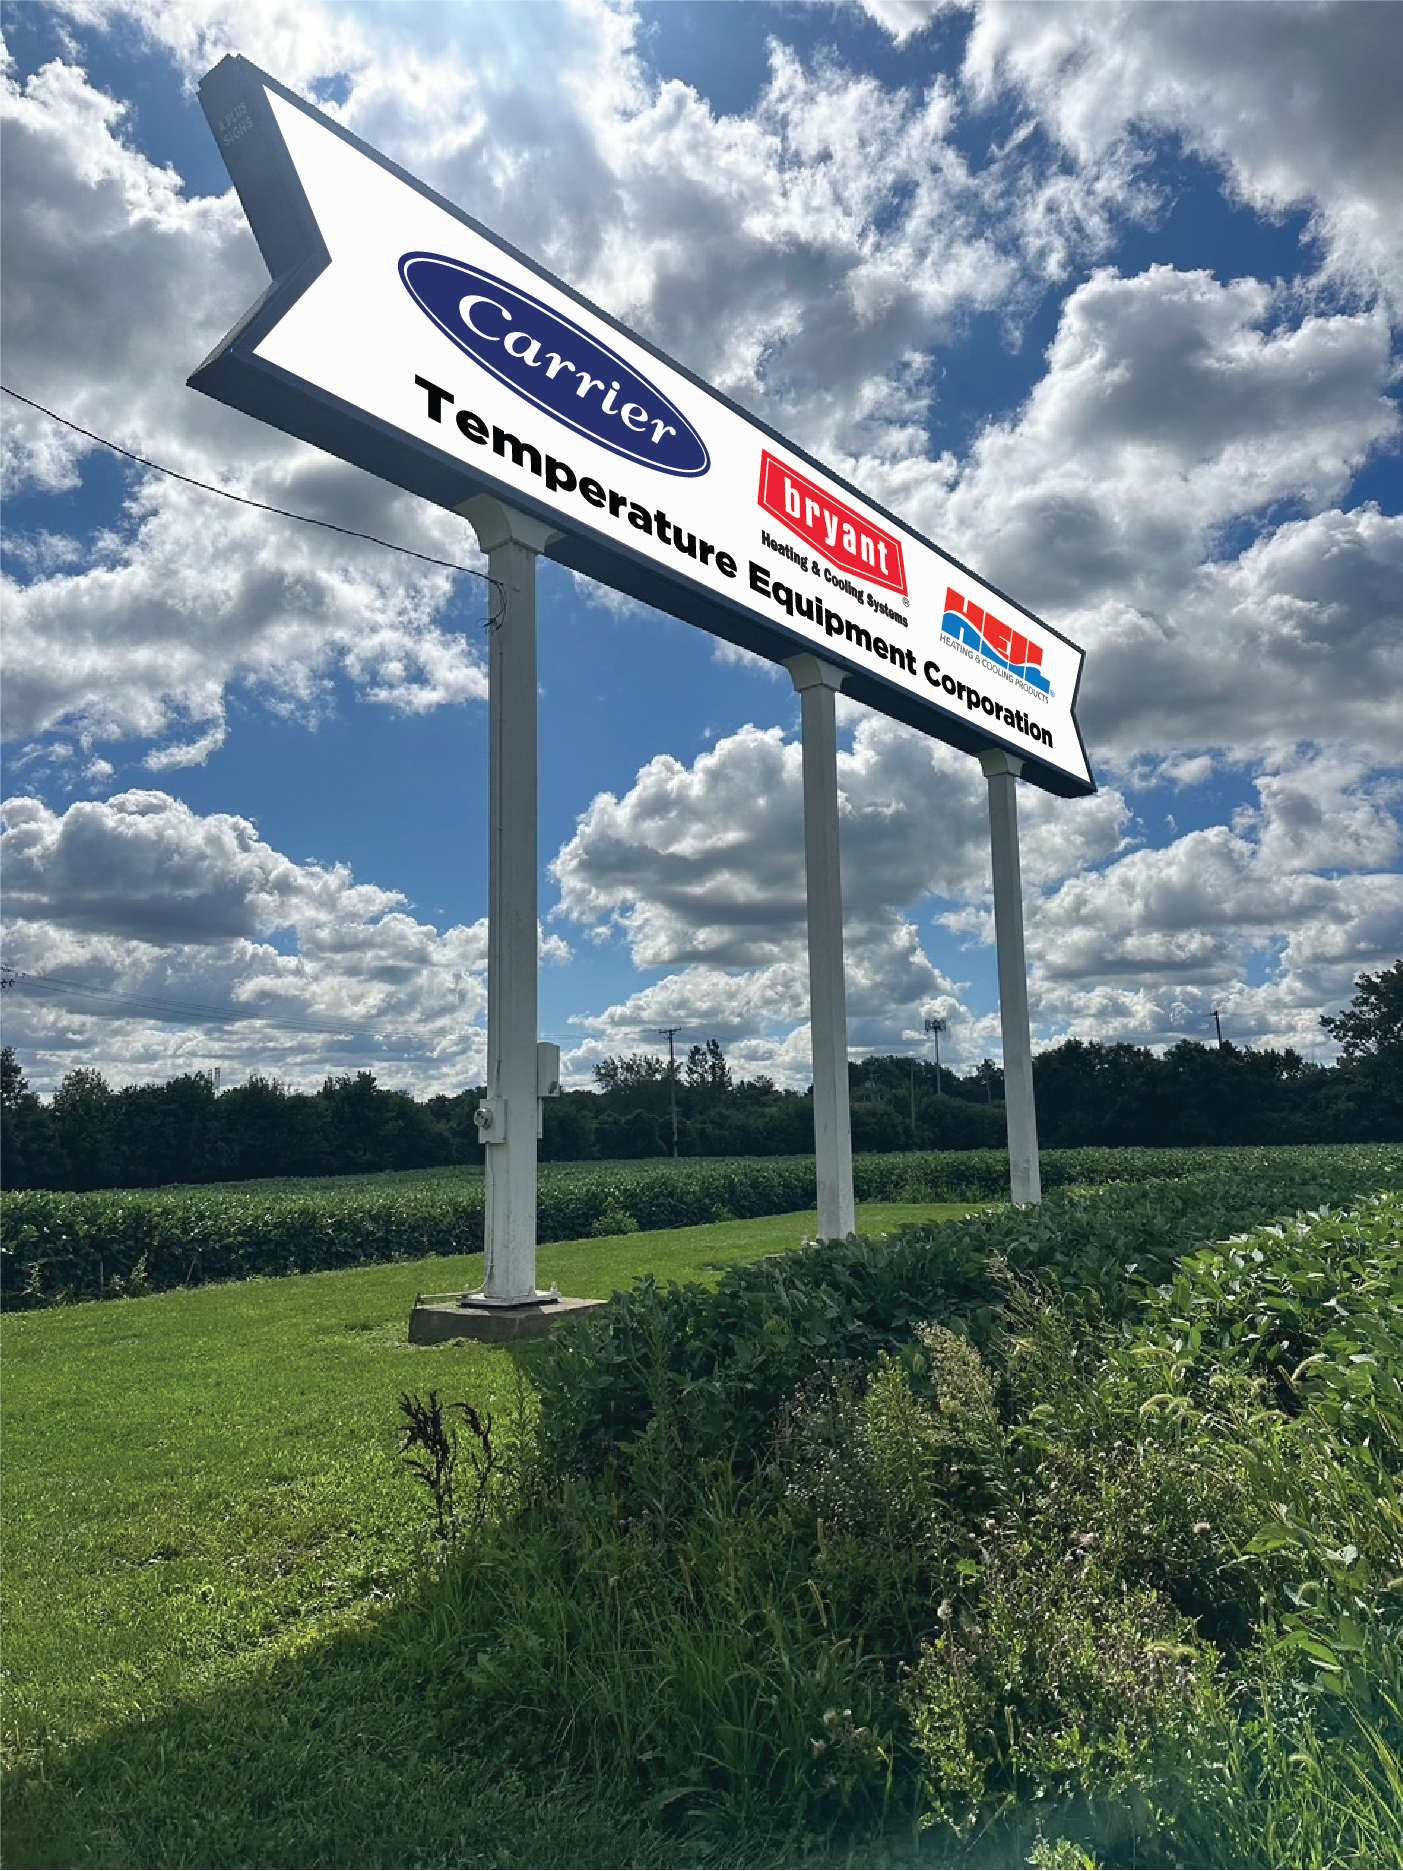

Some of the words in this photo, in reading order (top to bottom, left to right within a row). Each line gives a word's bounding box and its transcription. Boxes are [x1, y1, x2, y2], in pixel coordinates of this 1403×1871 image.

[223, 116, 253, 147] SIGNS
[459, 295, 677, 444] Carrier
[414, 373, 737, 579] Temperature
[748, 560, 917, 676] Equipment
[924, 660, 1054, 749] Corporation
[784, 476, 889, 576] bryant
[761, 529, 808, 573] Heating
[811, 560, 821, 577] &
[824, 568, 864, 605] Cooling
[867, 593, 909, 628] Systems
[940, 633, 974, 660] HEATING
[974, 654, 981, 665] &
[981, 658, 1014, 683] COOLING
[1014, 678, 1049, 704] PRODUCTS
